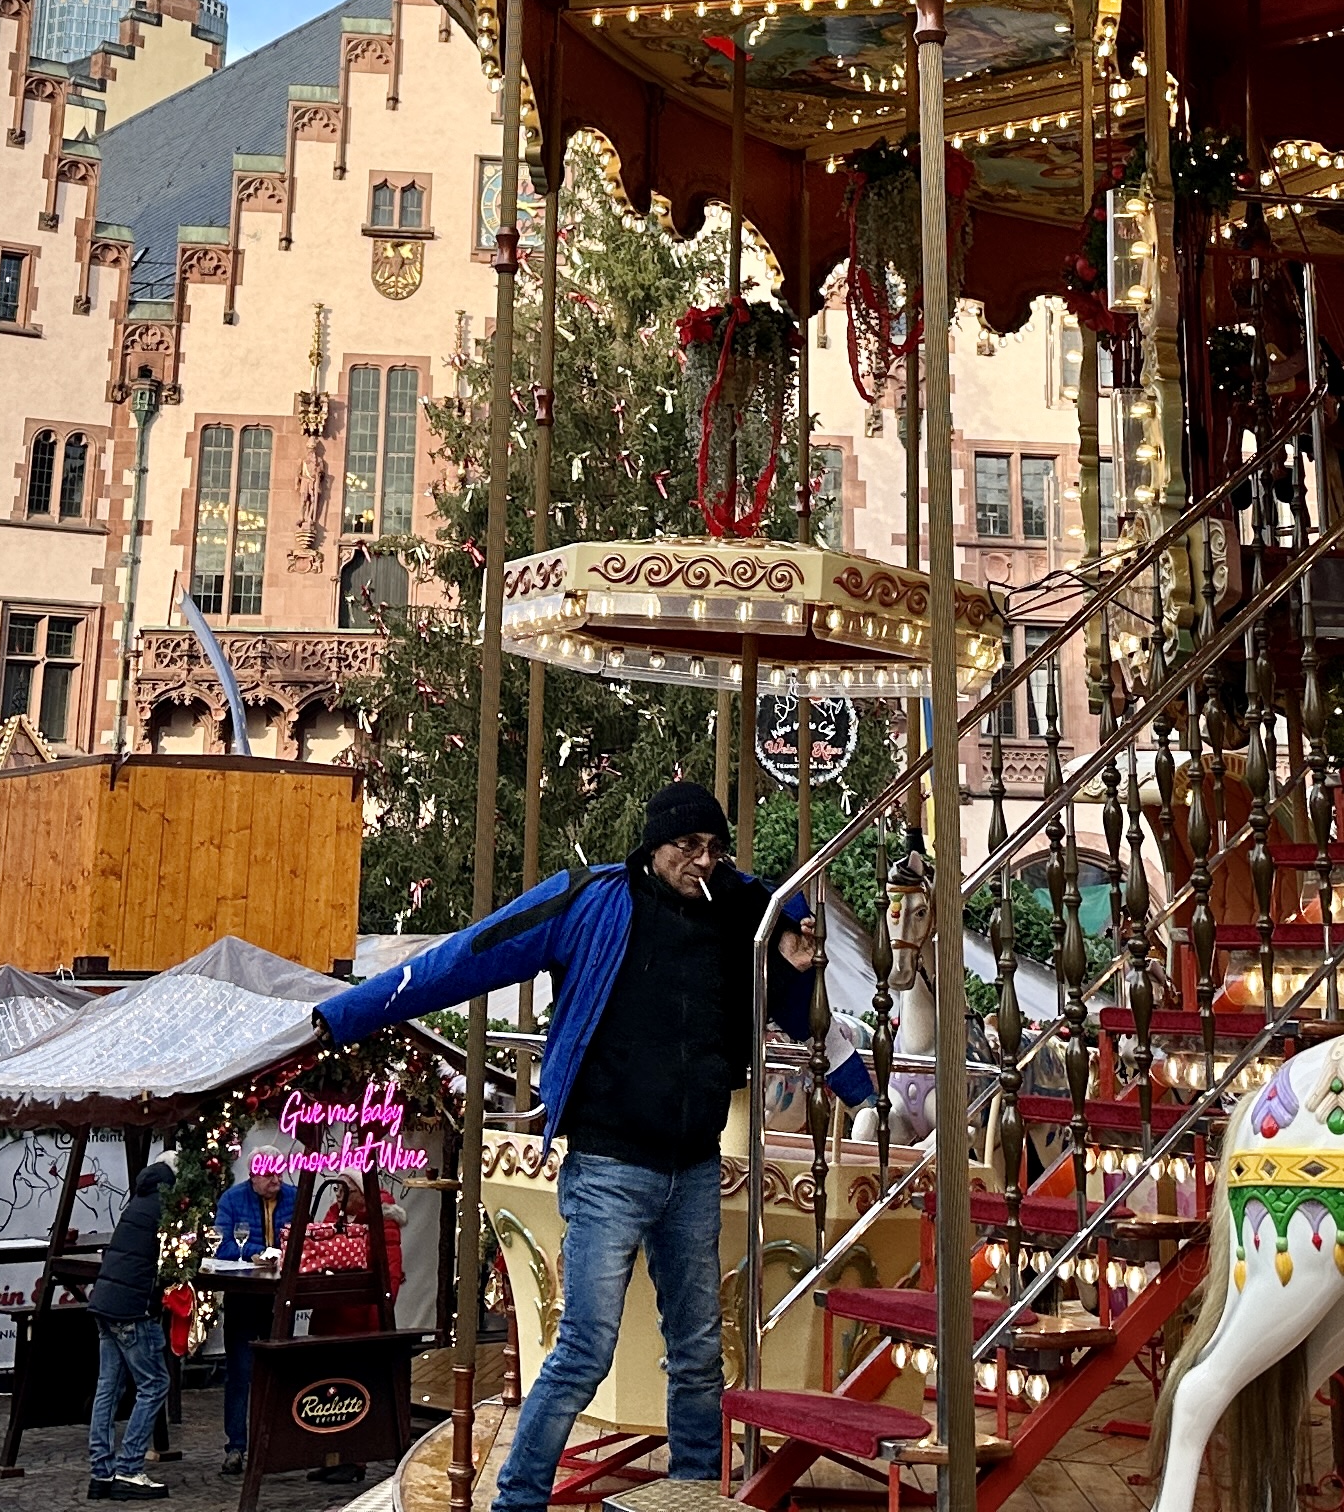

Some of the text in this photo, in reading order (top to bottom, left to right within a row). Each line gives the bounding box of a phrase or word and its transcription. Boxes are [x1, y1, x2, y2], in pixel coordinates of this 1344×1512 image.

[280, 1082, 403, 1139] Give me baby
[251, 1131, 429, 1175] one more hot Wine
[301, 1395, 363, 1418] Raclette
